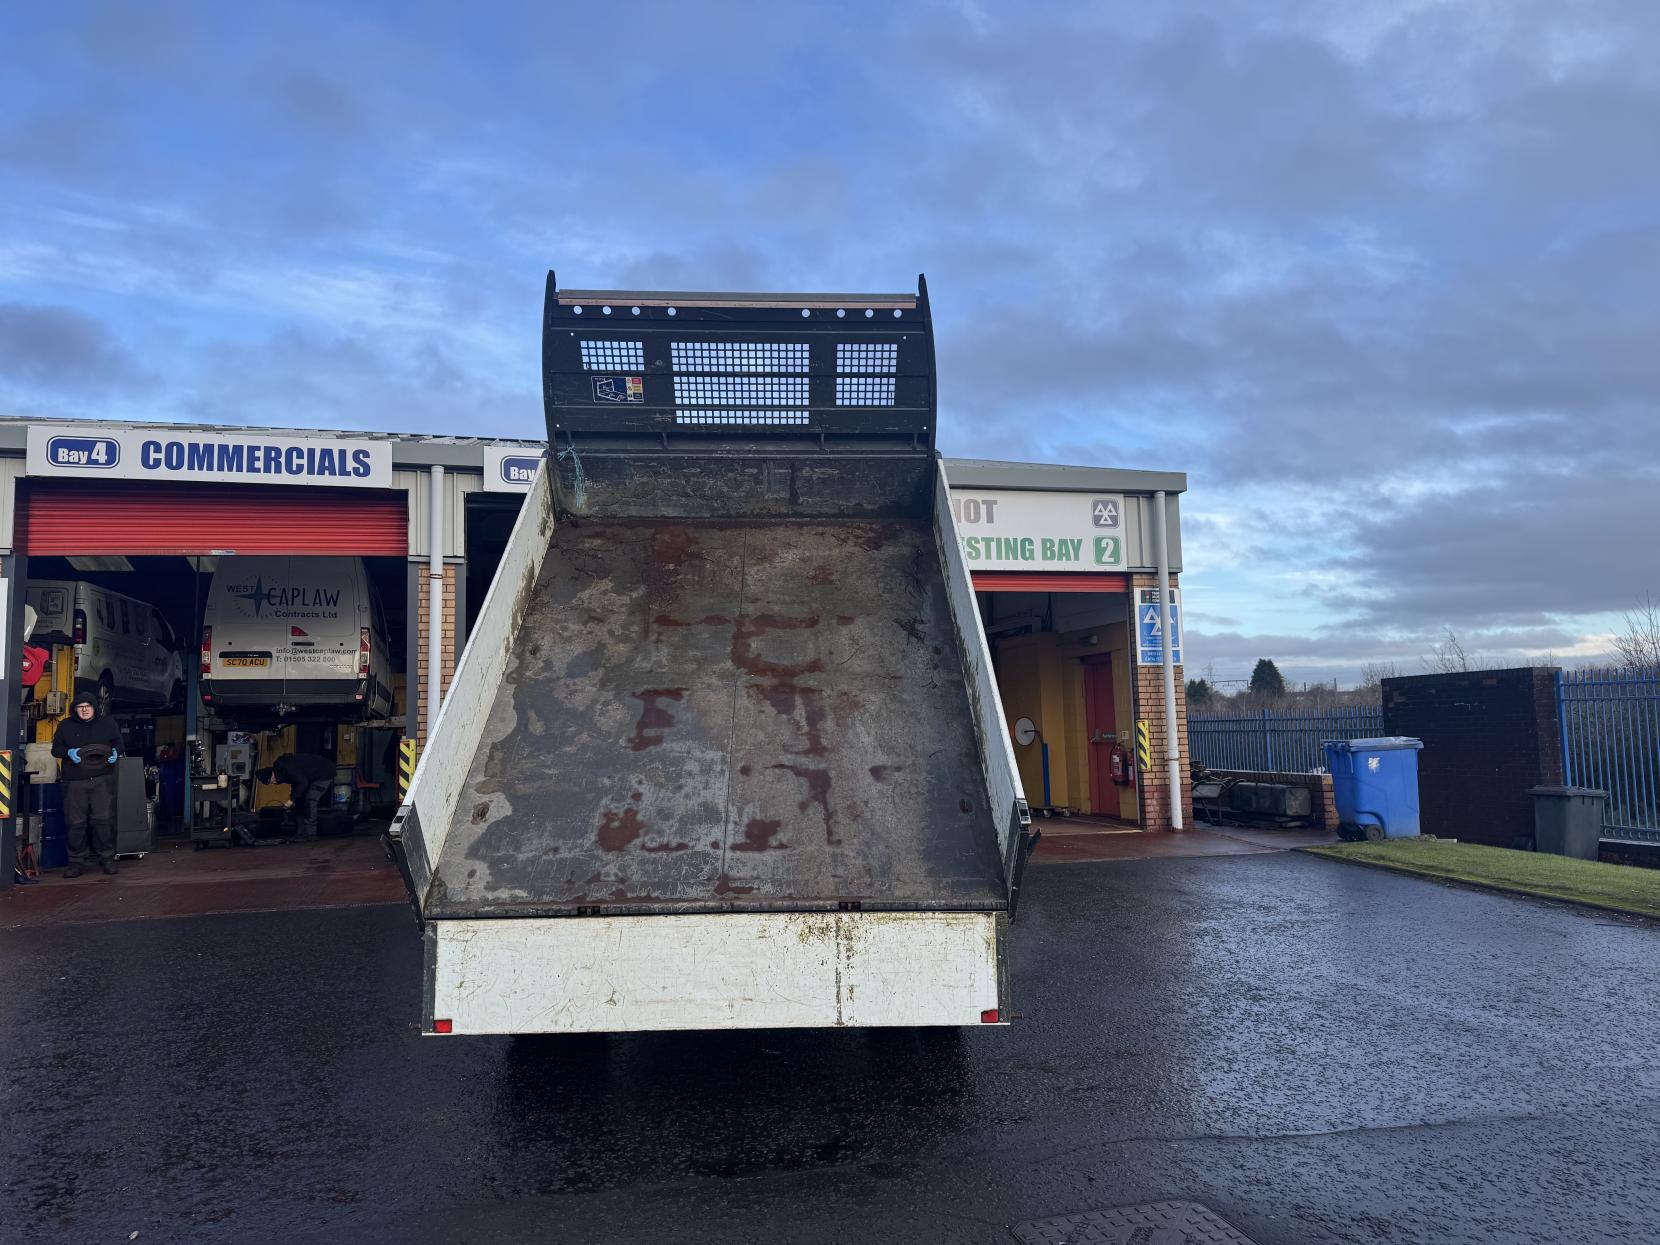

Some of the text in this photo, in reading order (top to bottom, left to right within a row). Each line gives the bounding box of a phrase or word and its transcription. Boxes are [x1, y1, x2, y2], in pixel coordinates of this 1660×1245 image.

[57, 441, 108, 464] Bay 4
[140, 440, 371, 478] COMMERCIALS
[509, 466, 536, 482] Bay
[951, 498, 998, 525] OT
[962, 536, 1117, 563] STING BAY 2
[226, 584, 341, 607] WEST CAPLAW
[274, 610, 337, 618] Contracts Ltd
[226, 658, 248, 666] SC70
